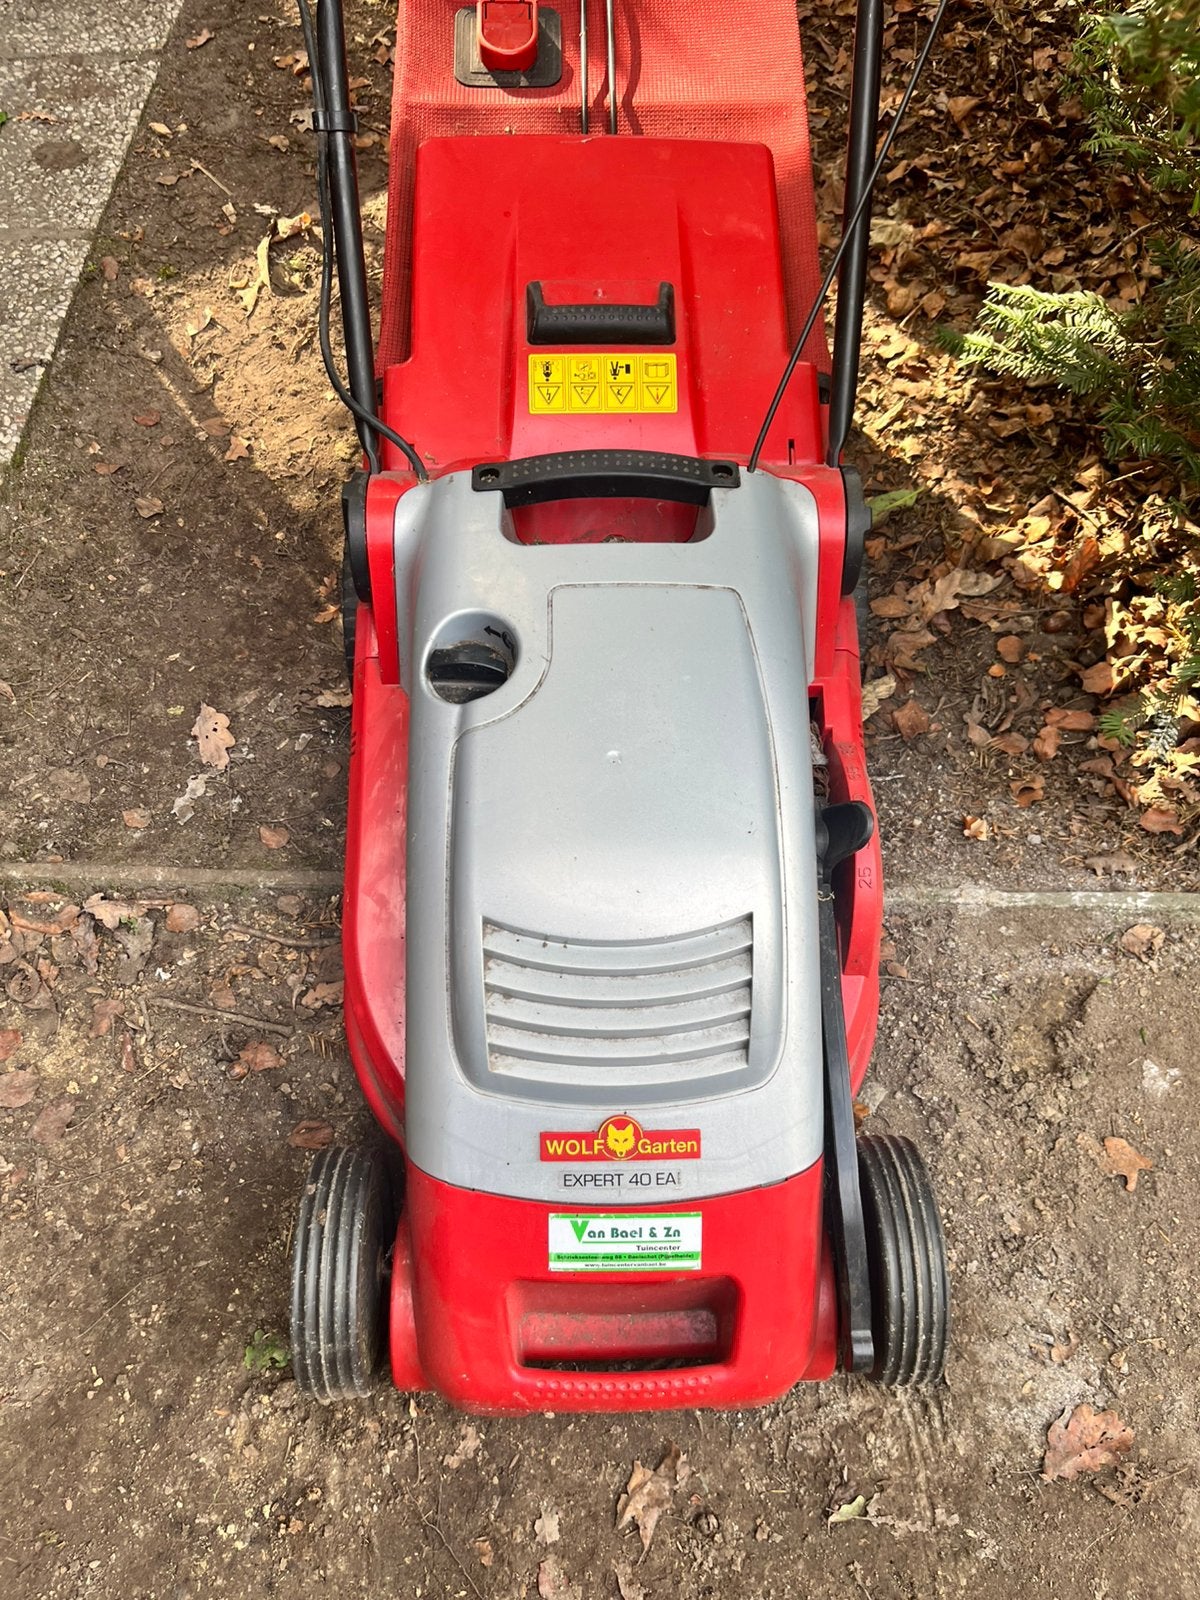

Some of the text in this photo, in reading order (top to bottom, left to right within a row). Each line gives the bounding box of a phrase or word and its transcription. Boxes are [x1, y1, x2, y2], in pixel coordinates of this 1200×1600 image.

[858, 867, 873, 889] 25
[545, 1138, 698, 1156] WOLF Garten
[563, 1173, 624, 1188] EXPERT
[628, 1172, 652, 1187] 40
[656, 1171, 677, 1186] EA
[570, 1220, 681, 1243] Van Bael & Zn
[636, 1244, 681, 1252] Tuincenter
